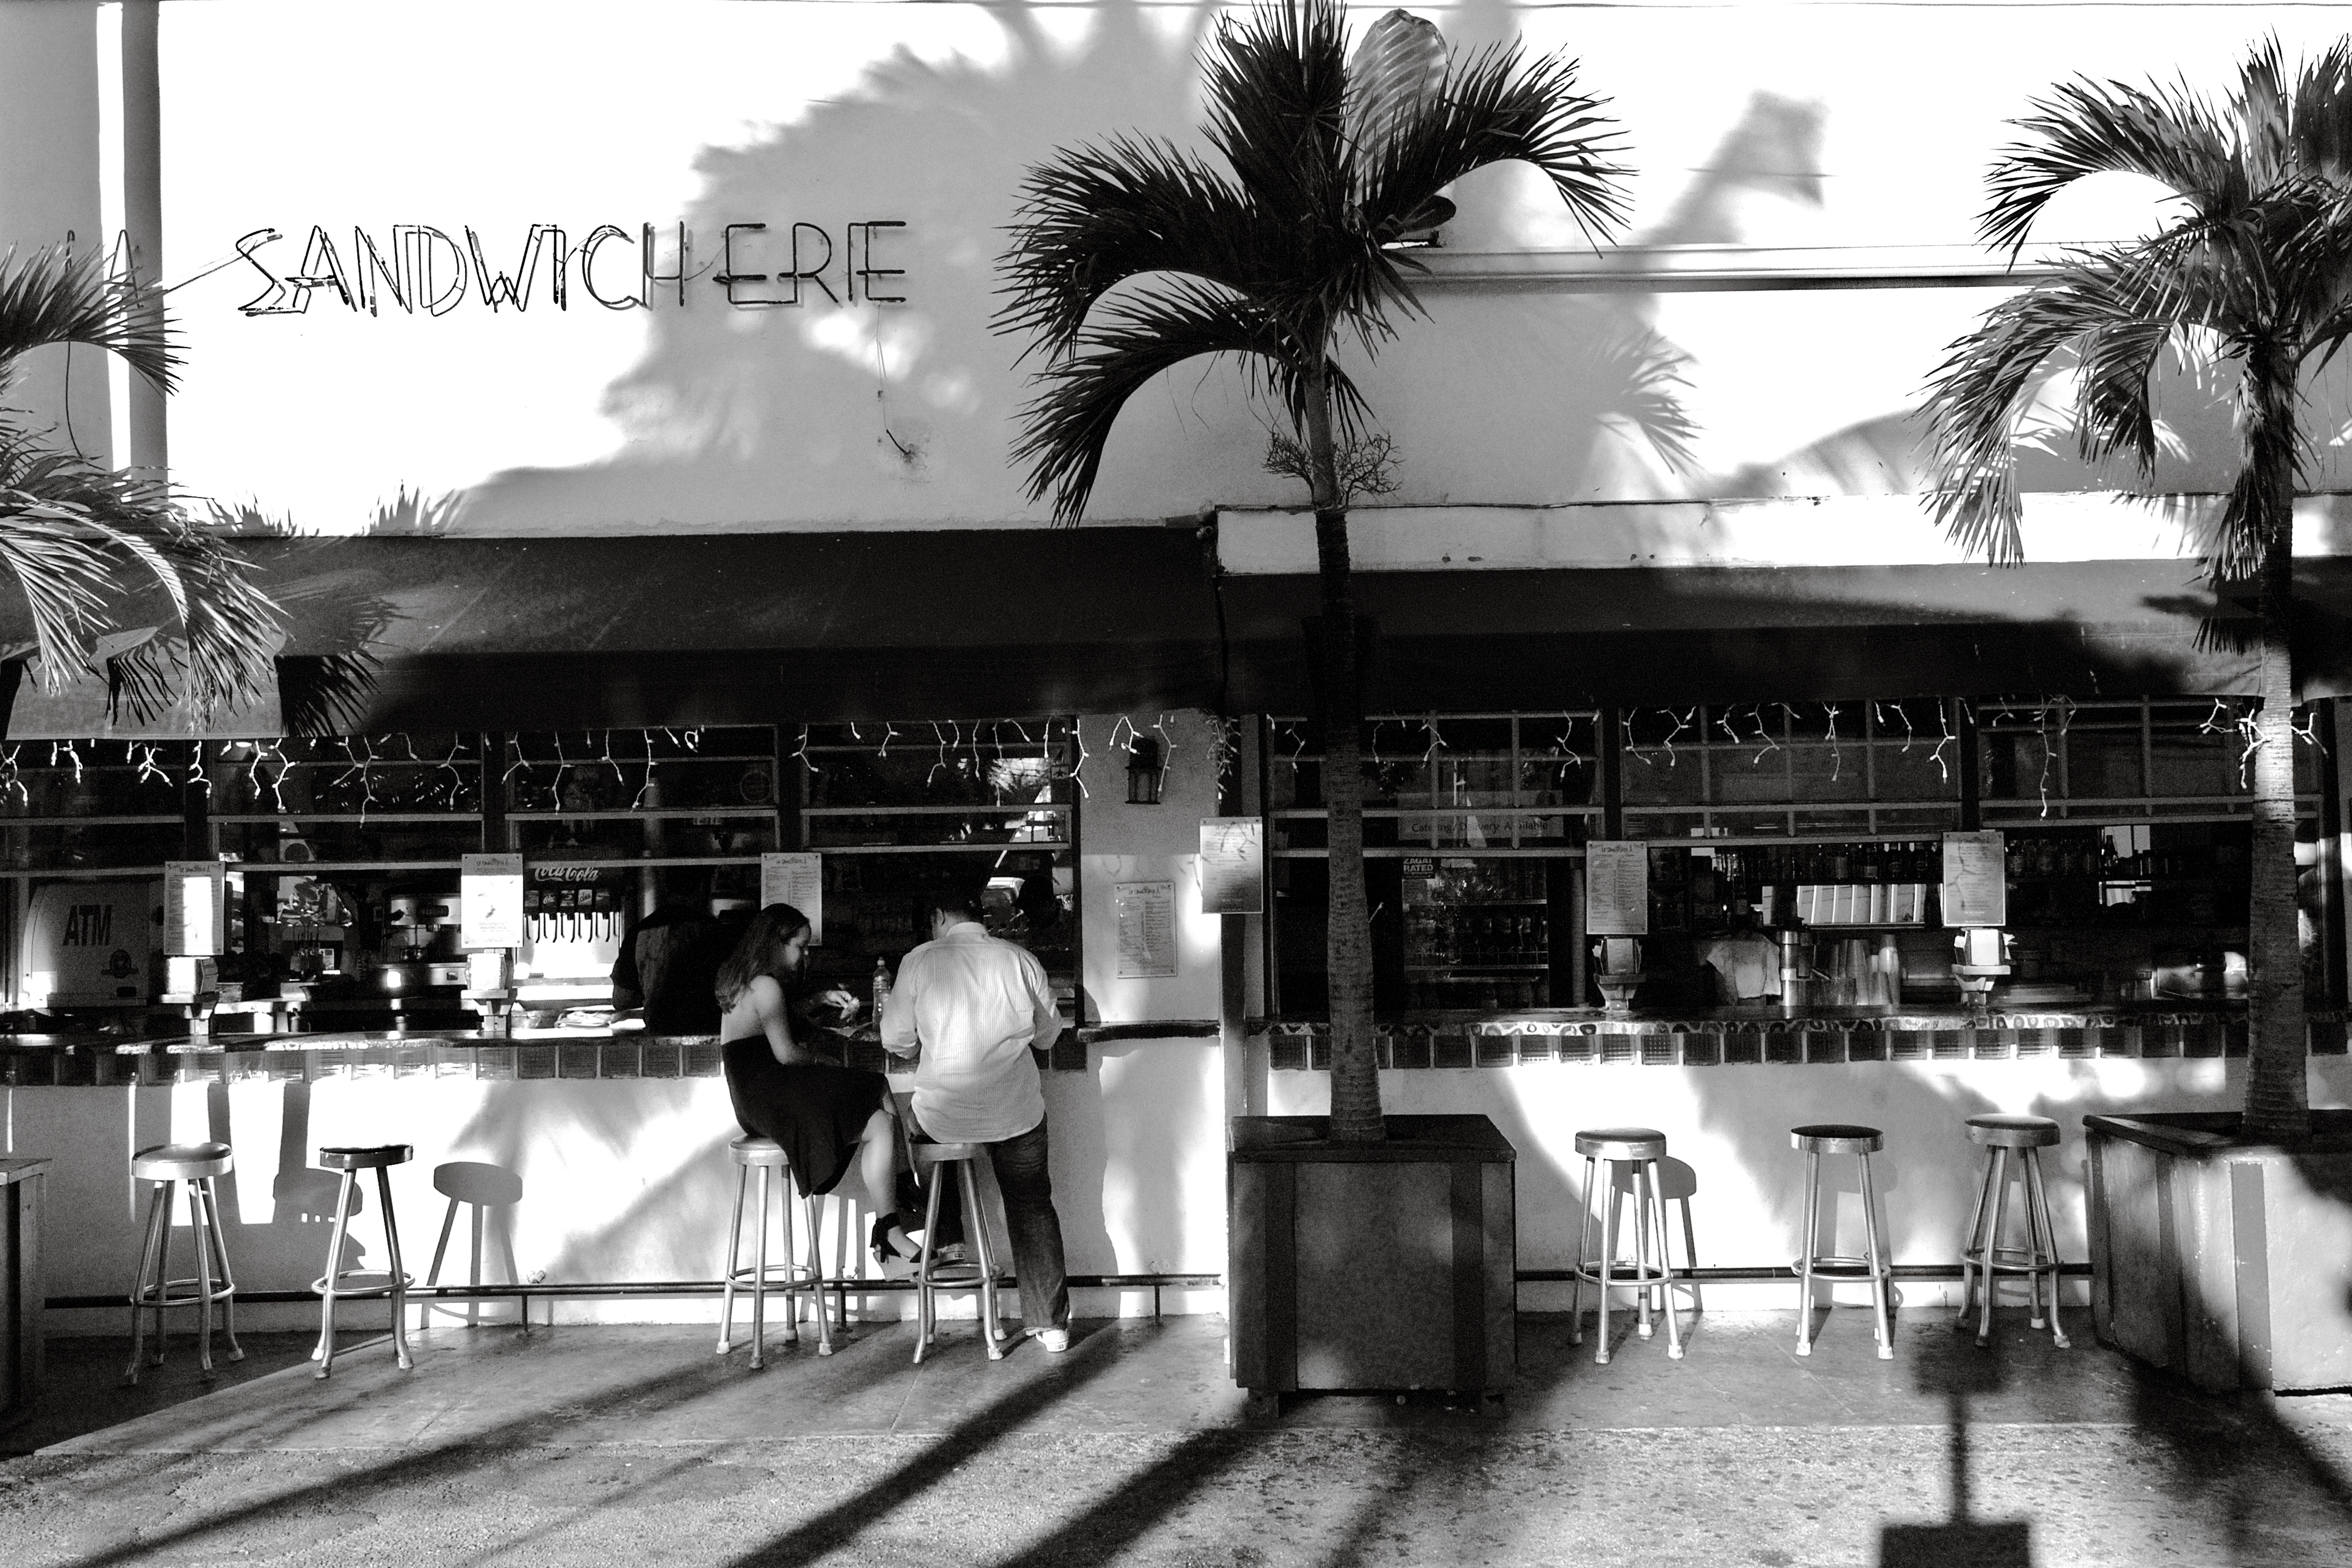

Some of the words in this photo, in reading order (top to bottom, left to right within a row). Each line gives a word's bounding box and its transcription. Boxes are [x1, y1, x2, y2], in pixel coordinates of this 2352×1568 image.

[236, 221, 906, 314] SANDWICHERIE
[1504, 820, 1548, 830] Aailable
[63, 905, 112, 946] ATM
